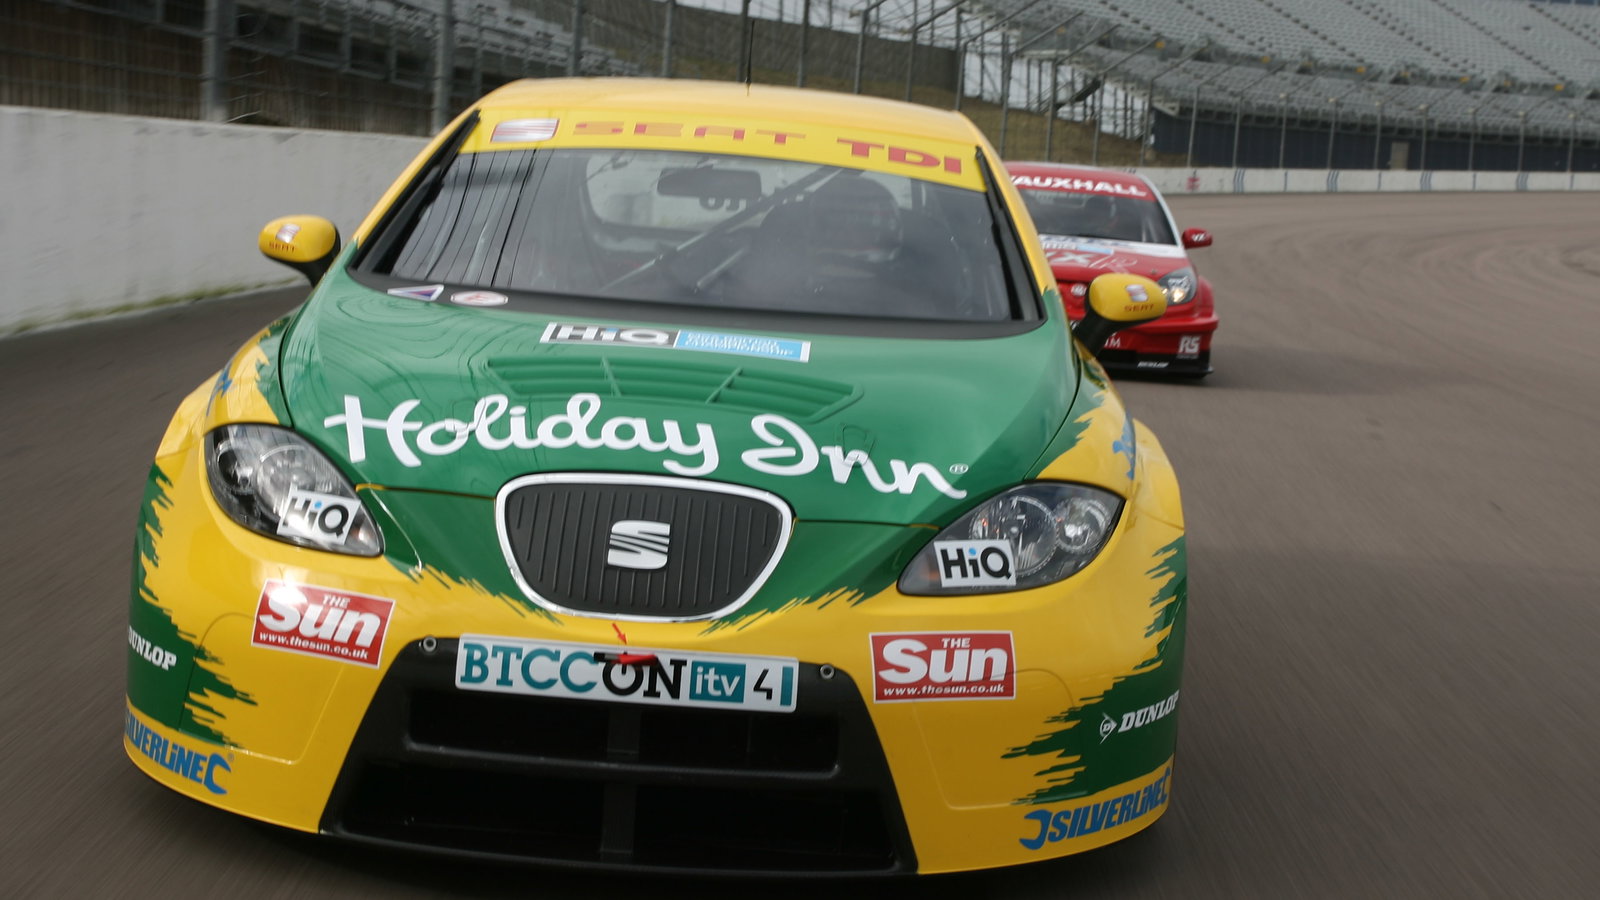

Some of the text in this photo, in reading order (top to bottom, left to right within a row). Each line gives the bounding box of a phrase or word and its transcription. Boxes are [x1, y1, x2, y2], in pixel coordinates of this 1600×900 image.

[573, 121, 963, 174] SEAT TDI
[1124, 303, 1154, 313] SEAT
[323, 393, 719, 476] Holiday
[282, 496, 350, 538] HiQ
[940, 546, 1012, 580] HiQ
[259, 585, 381, 648] Sun
[323, 594, 351, 606] THE
[259, 632, 369, 659] www.thesun.co.uk
[941, 637, 971, 649] THE
[878, 638, 1008, 684] Sun
[696, 667, 742, 697] itv
[883, 684, 1005, 697] www.thesun.co.uk
[1118, 689, 1180, 733] DUNLOP
